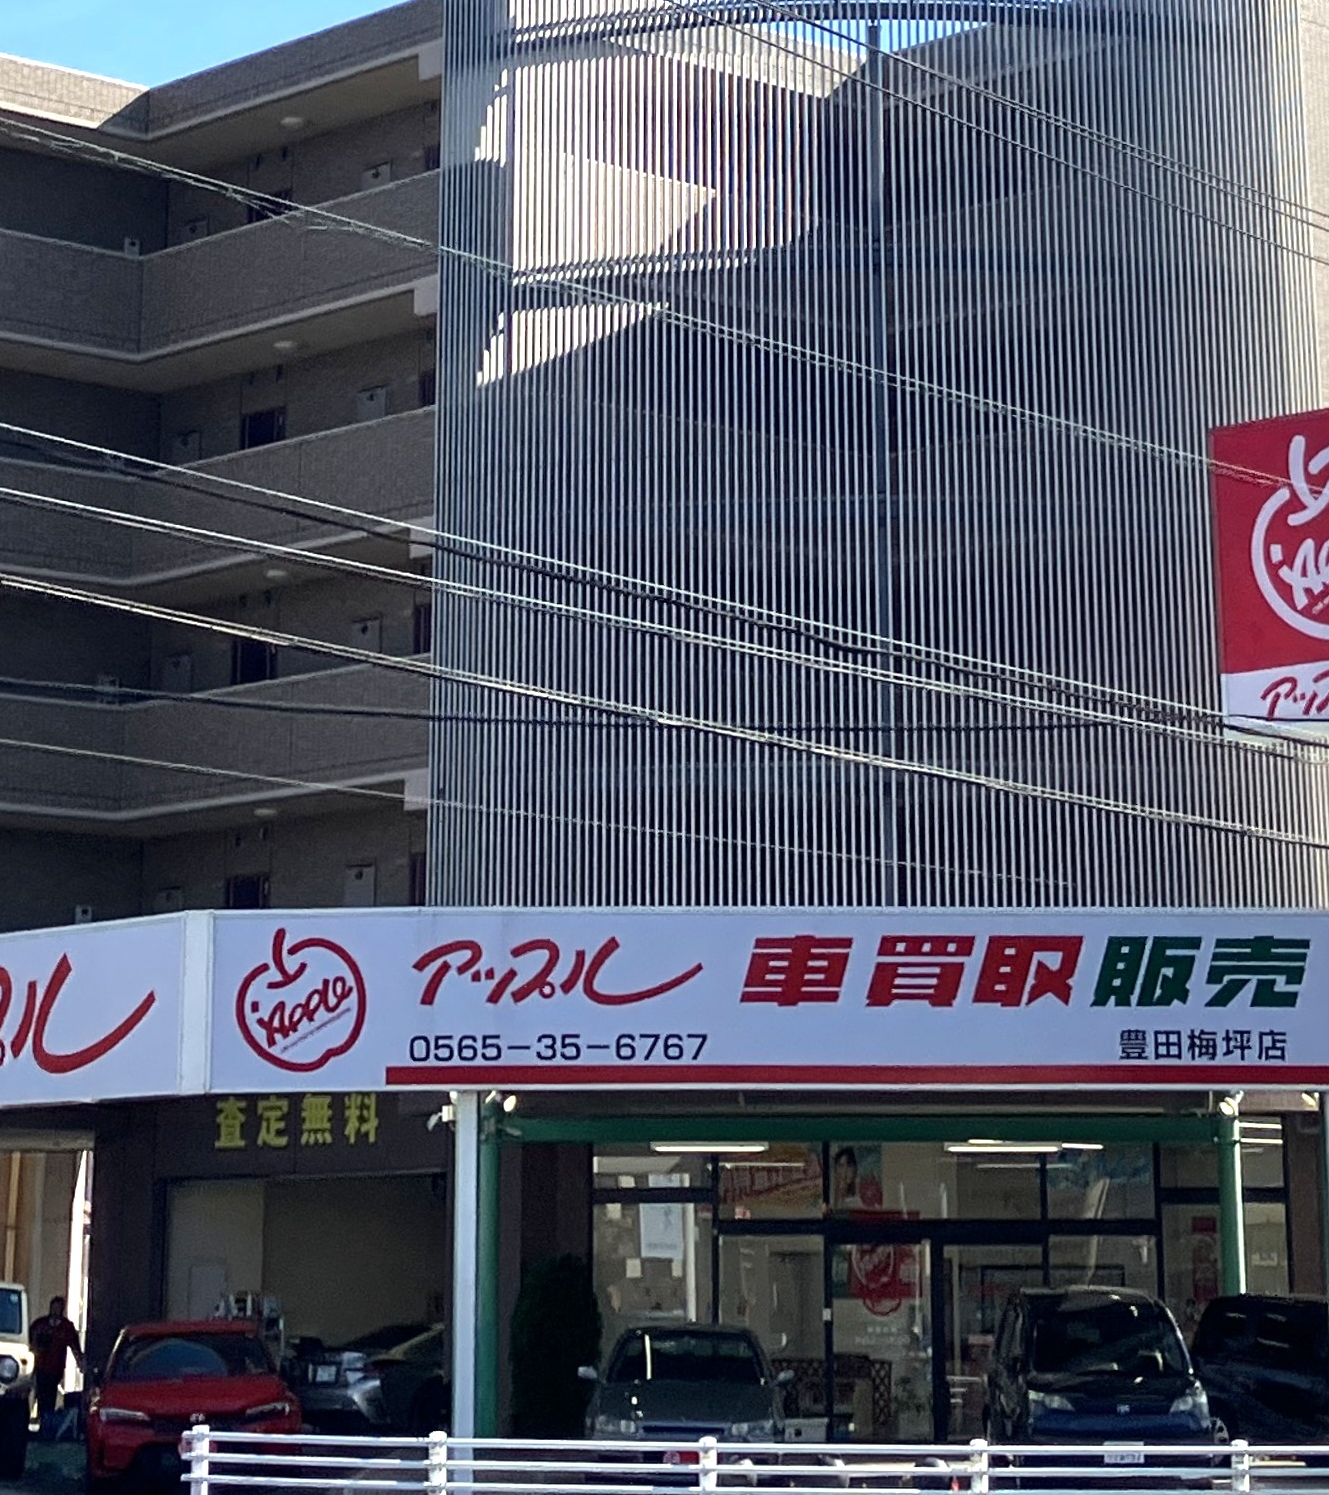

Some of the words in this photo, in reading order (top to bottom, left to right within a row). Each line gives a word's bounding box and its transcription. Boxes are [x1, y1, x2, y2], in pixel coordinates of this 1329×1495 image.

[412, 936, 703, 1006] アップル
[409, 1034, 708, 1062] 0565-35-6767
[215, 1093, 379, 1149] 査定無料
